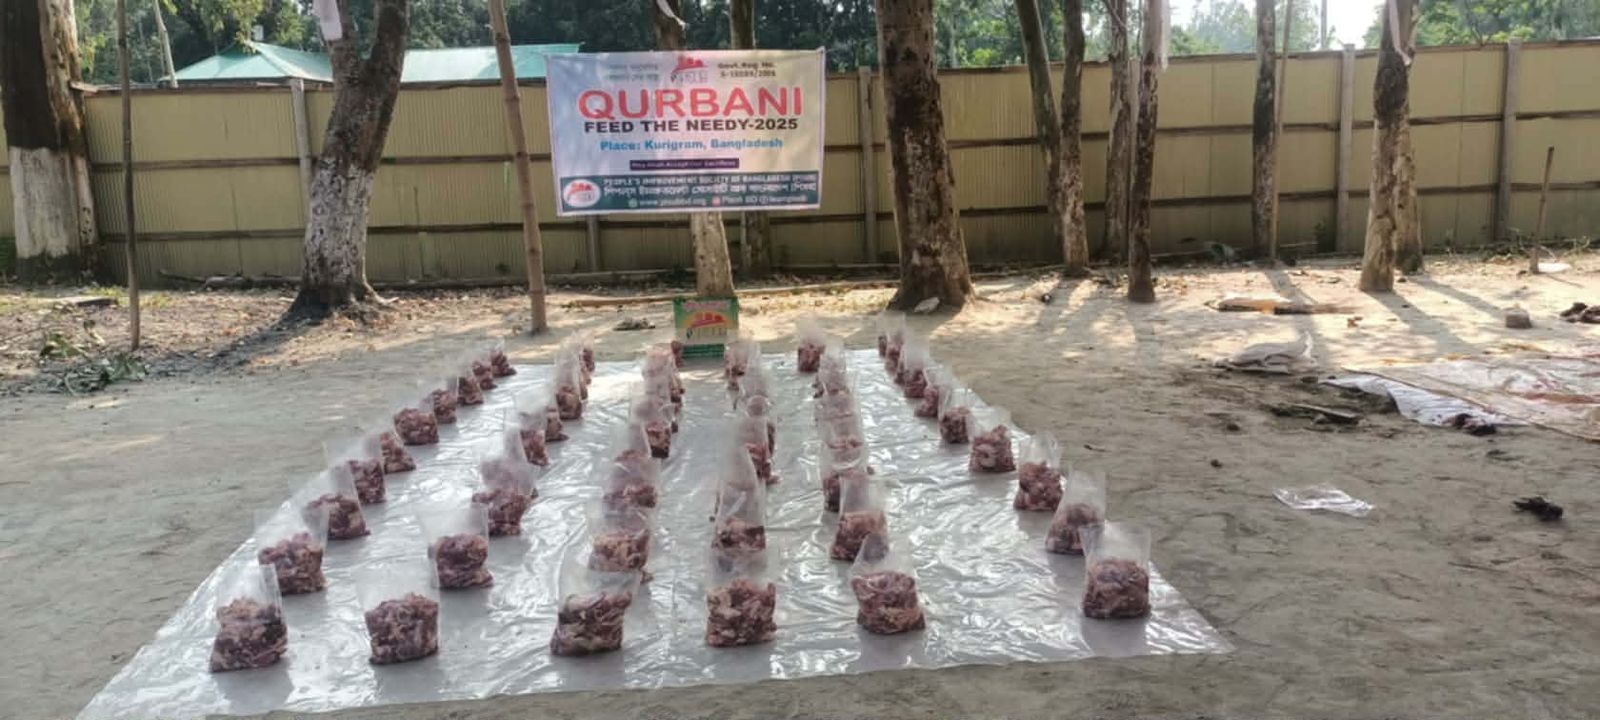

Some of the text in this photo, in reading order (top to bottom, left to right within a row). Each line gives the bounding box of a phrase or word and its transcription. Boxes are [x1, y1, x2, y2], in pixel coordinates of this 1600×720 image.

[578, 86, 802, 120] QURBANI
[584, 118, 798, 133] FEED THE NEEDY-2025
[600, 138, 784, 152] Place: Kurigram, Bangladesh
